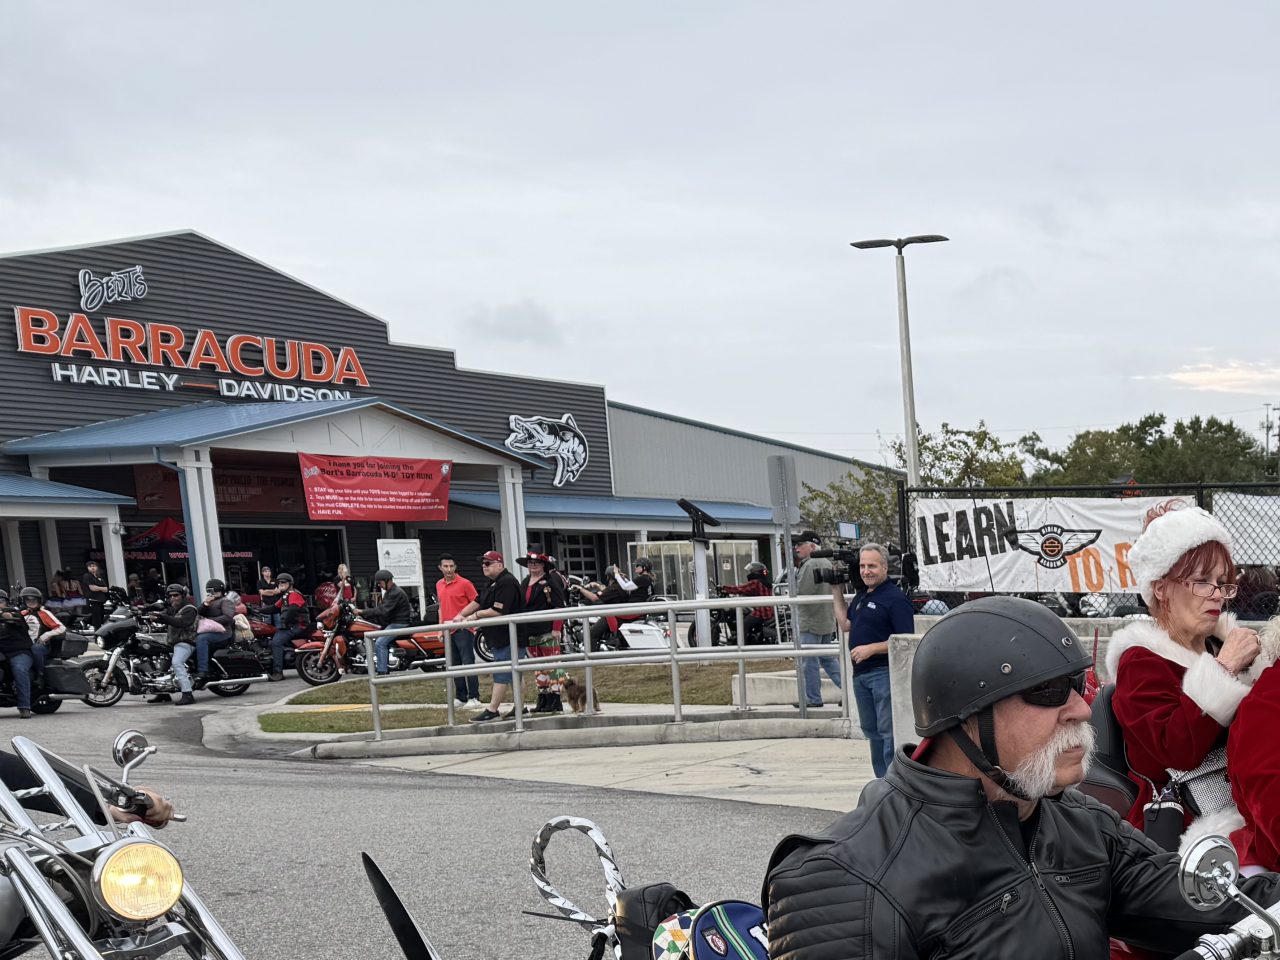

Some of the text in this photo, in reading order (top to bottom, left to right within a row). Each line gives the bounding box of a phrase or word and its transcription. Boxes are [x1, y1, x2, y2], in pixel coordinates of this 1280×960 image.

[13, 305, 371, 387] BARRACUDA
[51, 363, 351, 401] HARLEY DAVIDSON
[917, 501, 1020, 565] LEARN
[1065, 546, 1105, 593] TO
